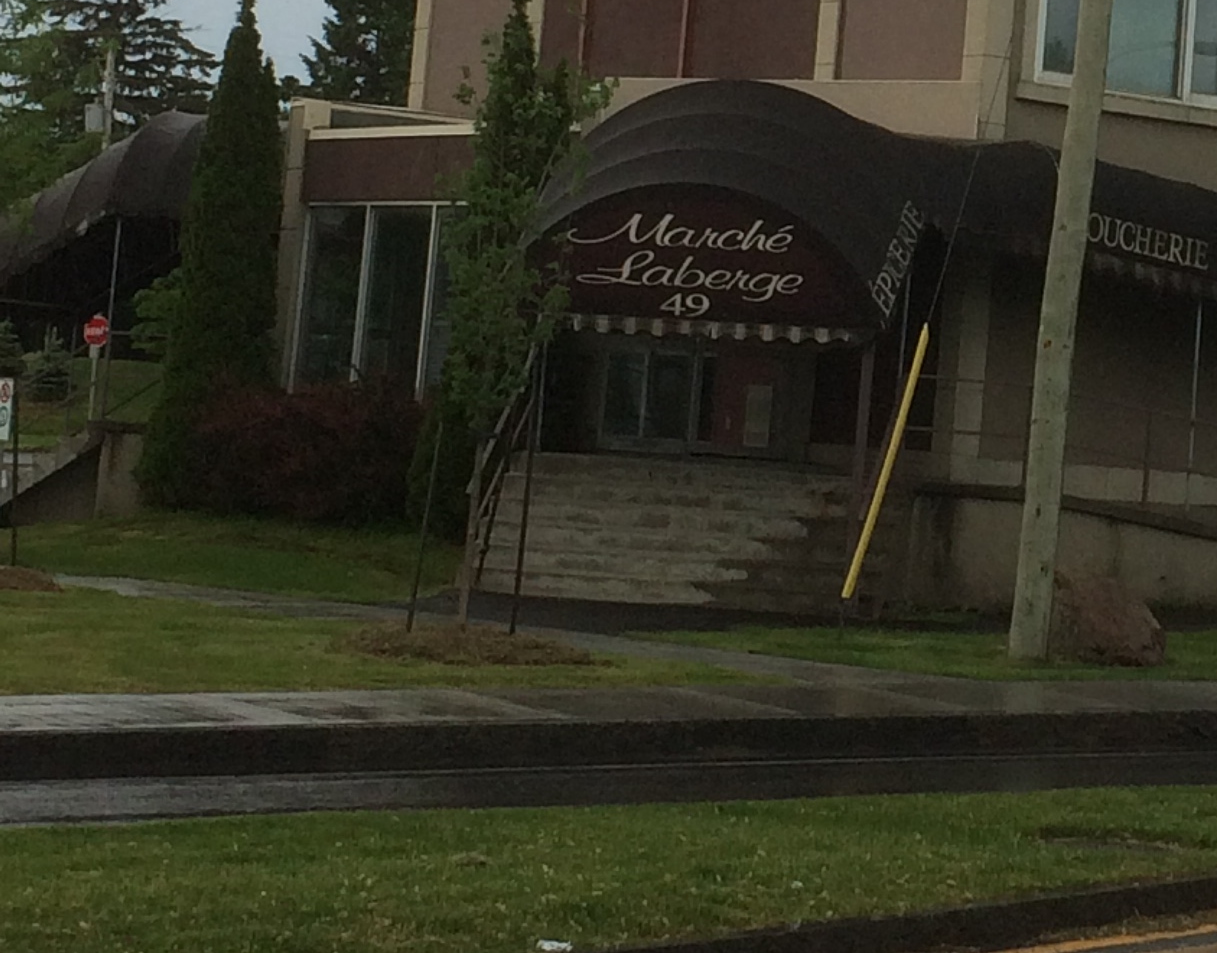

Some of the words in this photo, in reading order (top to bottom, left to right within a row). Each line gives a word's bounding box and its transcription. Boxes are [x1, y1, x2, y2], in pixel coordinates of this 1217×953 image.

[567, 213, 795, 253] Marché
[1087, 211, 1209, 271] OUCHERIE
[576, 249, 804, 302] Laberge
[660, 293, 710, 318] 49
